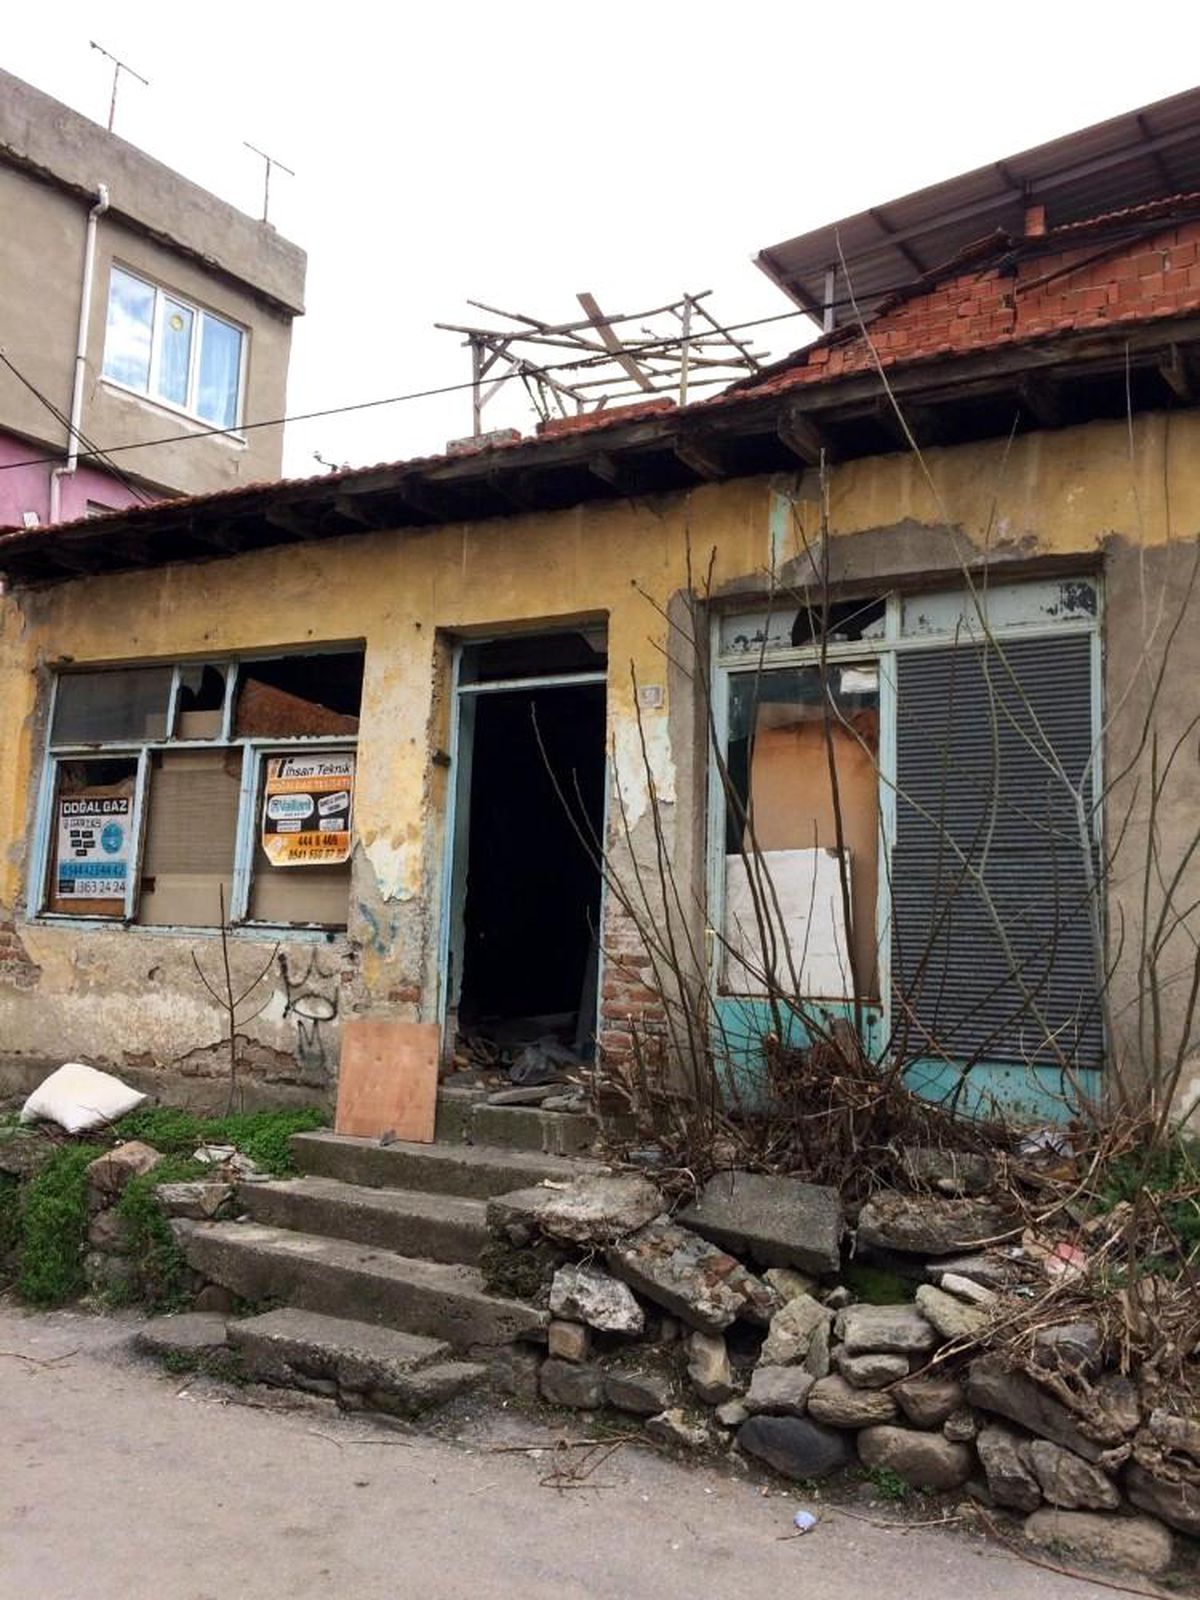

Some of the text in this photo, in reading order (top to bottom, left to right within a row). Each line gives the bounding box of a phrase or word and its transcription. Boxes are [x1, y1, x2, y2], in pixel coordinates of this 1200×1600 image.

[317, 762, 350, 775] Teknik
[103, 800, 127, 813] GAZ
[99, 881, 111, 893] 24
[113, 881, 126, 892] 24
